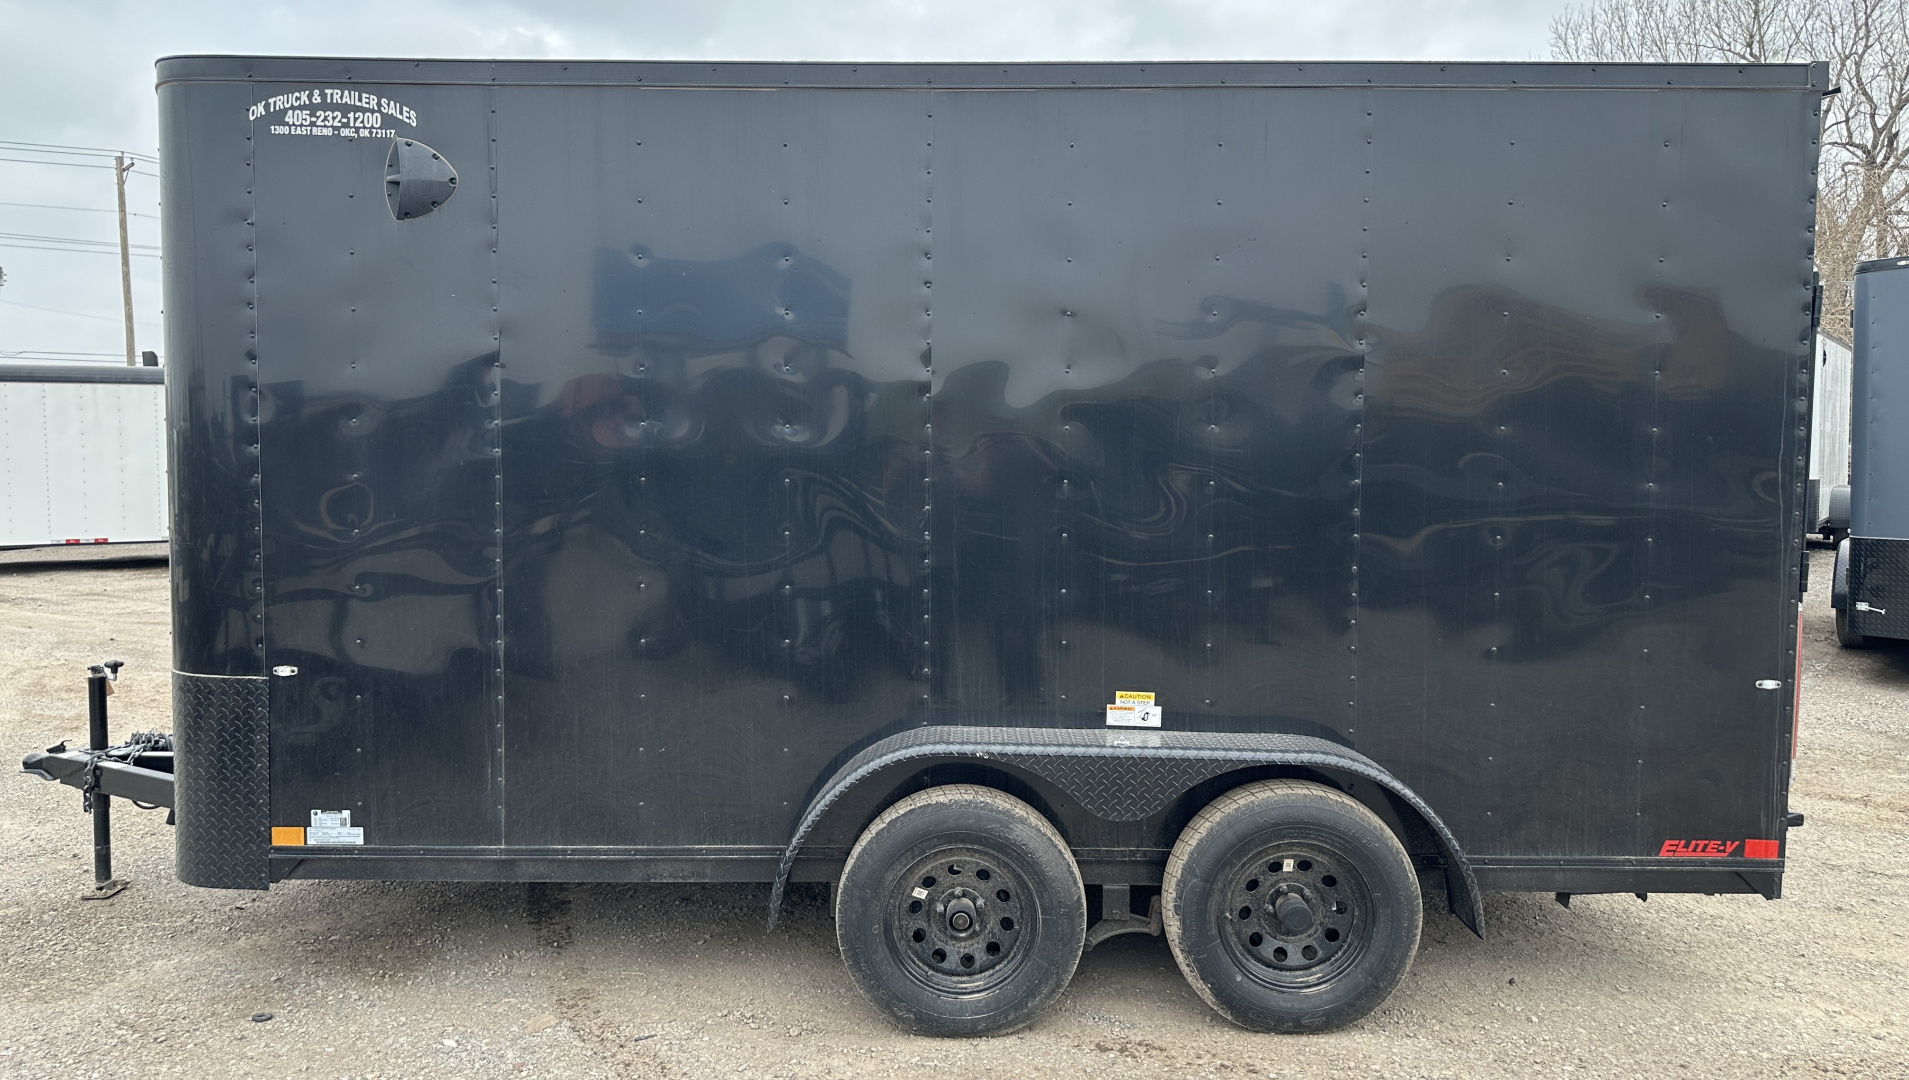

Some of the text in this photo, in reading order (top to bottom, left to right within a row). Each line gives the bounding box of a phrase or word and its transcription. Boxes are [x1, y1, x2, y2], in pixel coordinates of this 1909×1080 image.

[248, 89, 418, 128] OK TRUCK & TRAILER SALES
[284, 109, 382, 128] 405-232-1200
[270, 126, 290, 135] 1300
[290, 126, 311, 136] EAST
[312, 127, 332, 136] RENO
[340, 128, 358, 139] OKC,
[359, 129, 371, 138] OK
[371, 129, 396, 138] 73117
[1658, 839, 1741, 857] ELITE-V
